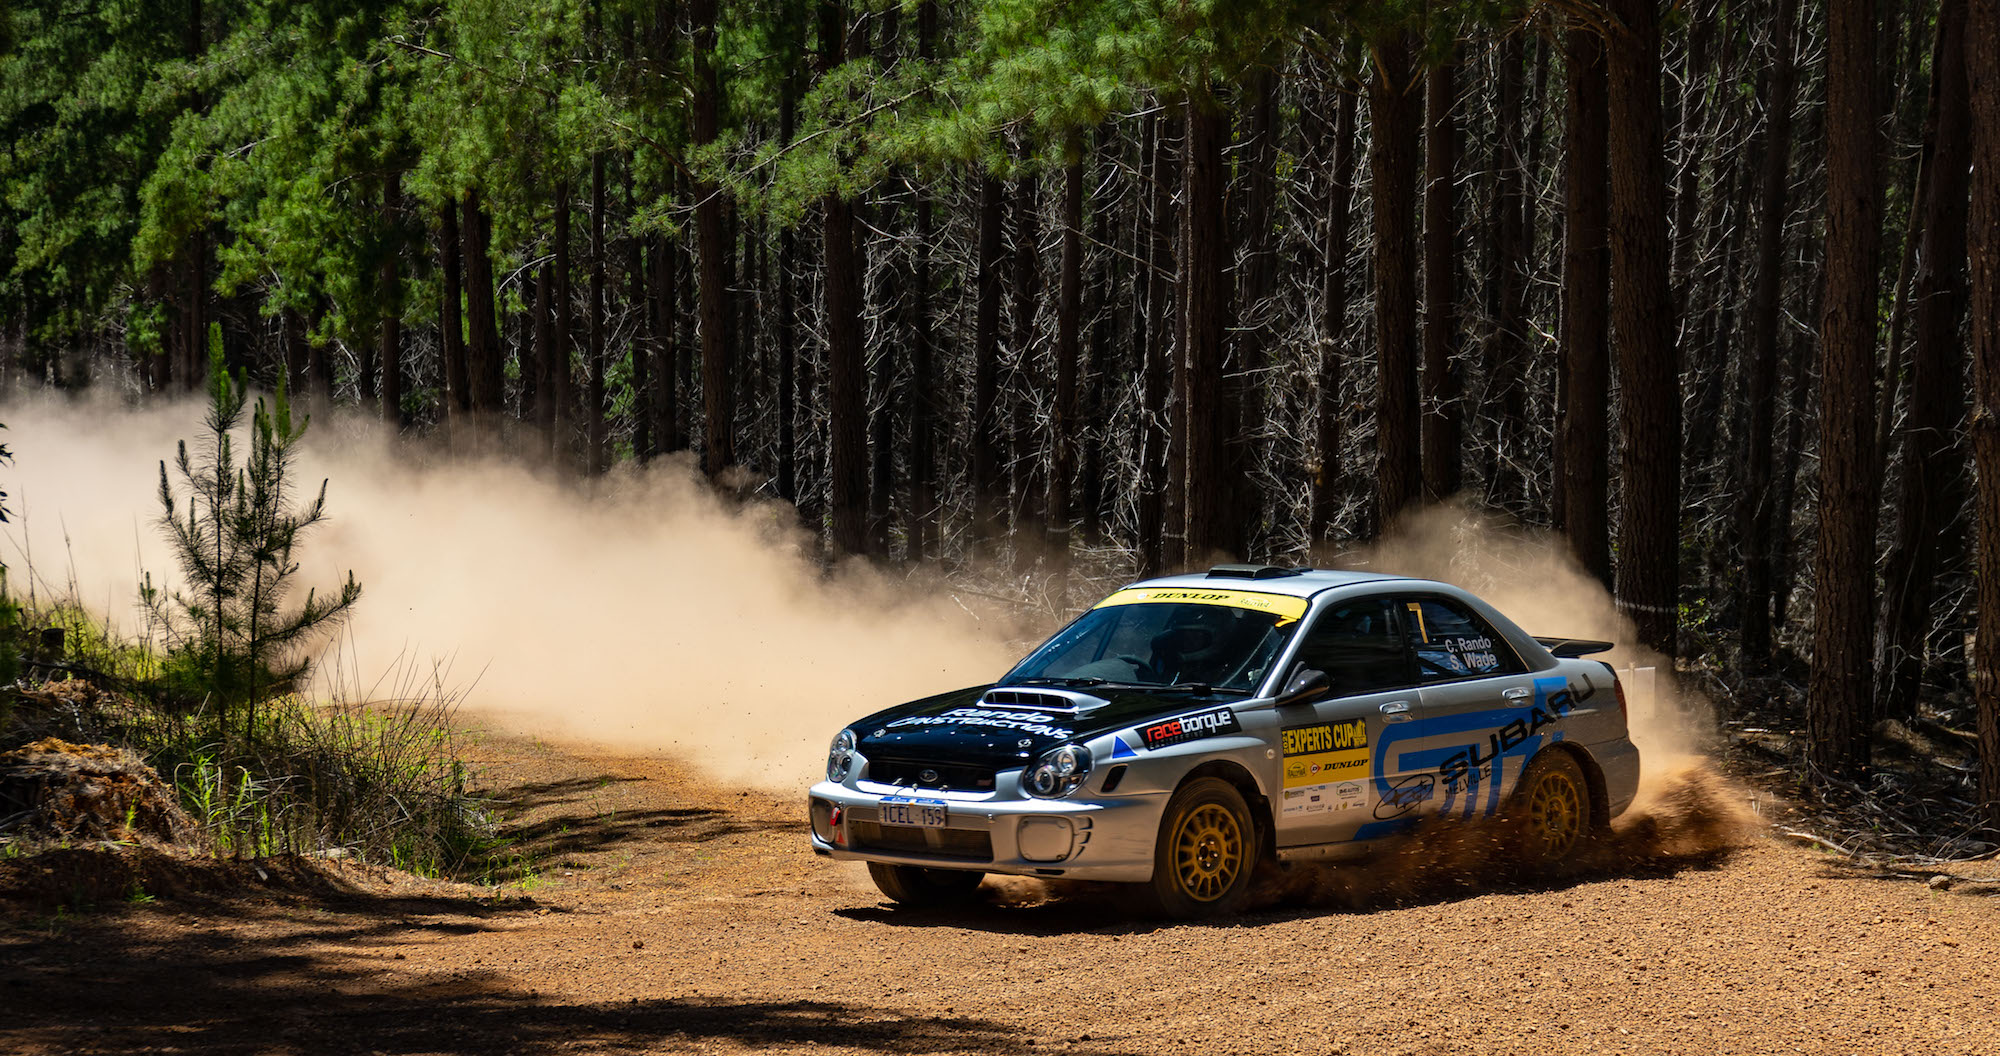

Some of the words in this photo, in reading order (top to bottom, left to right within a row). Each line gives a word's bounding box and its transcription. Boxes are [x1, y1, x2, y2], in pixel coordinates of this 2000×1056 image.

[1152, 592, 1231, 601] DUNLOP
[1274, 615, 1298, 628] 7
[1445, 638, 1458, 653] C.
[1457, 635, 1492, 652] Rando
[1449, 654, 1463, 670] S.
[1463, 651, 1497, 669] Wade
[941, 708, 1056, 723] Rando
[1146, 710, 1232, 742] racetorque
[1439, 673, 1596, 785] SUBARU
[1287, 725, 1333, 754] EXPERTS
[1333, 723, 1354, 749] CUP
[1323, 759, 1368, 771] DUNLOP
[1445, 764, 1491, 800] MELVILLE
[882, 805, 914, 824] 1CEL
[922, 807, 943, 825] 159
